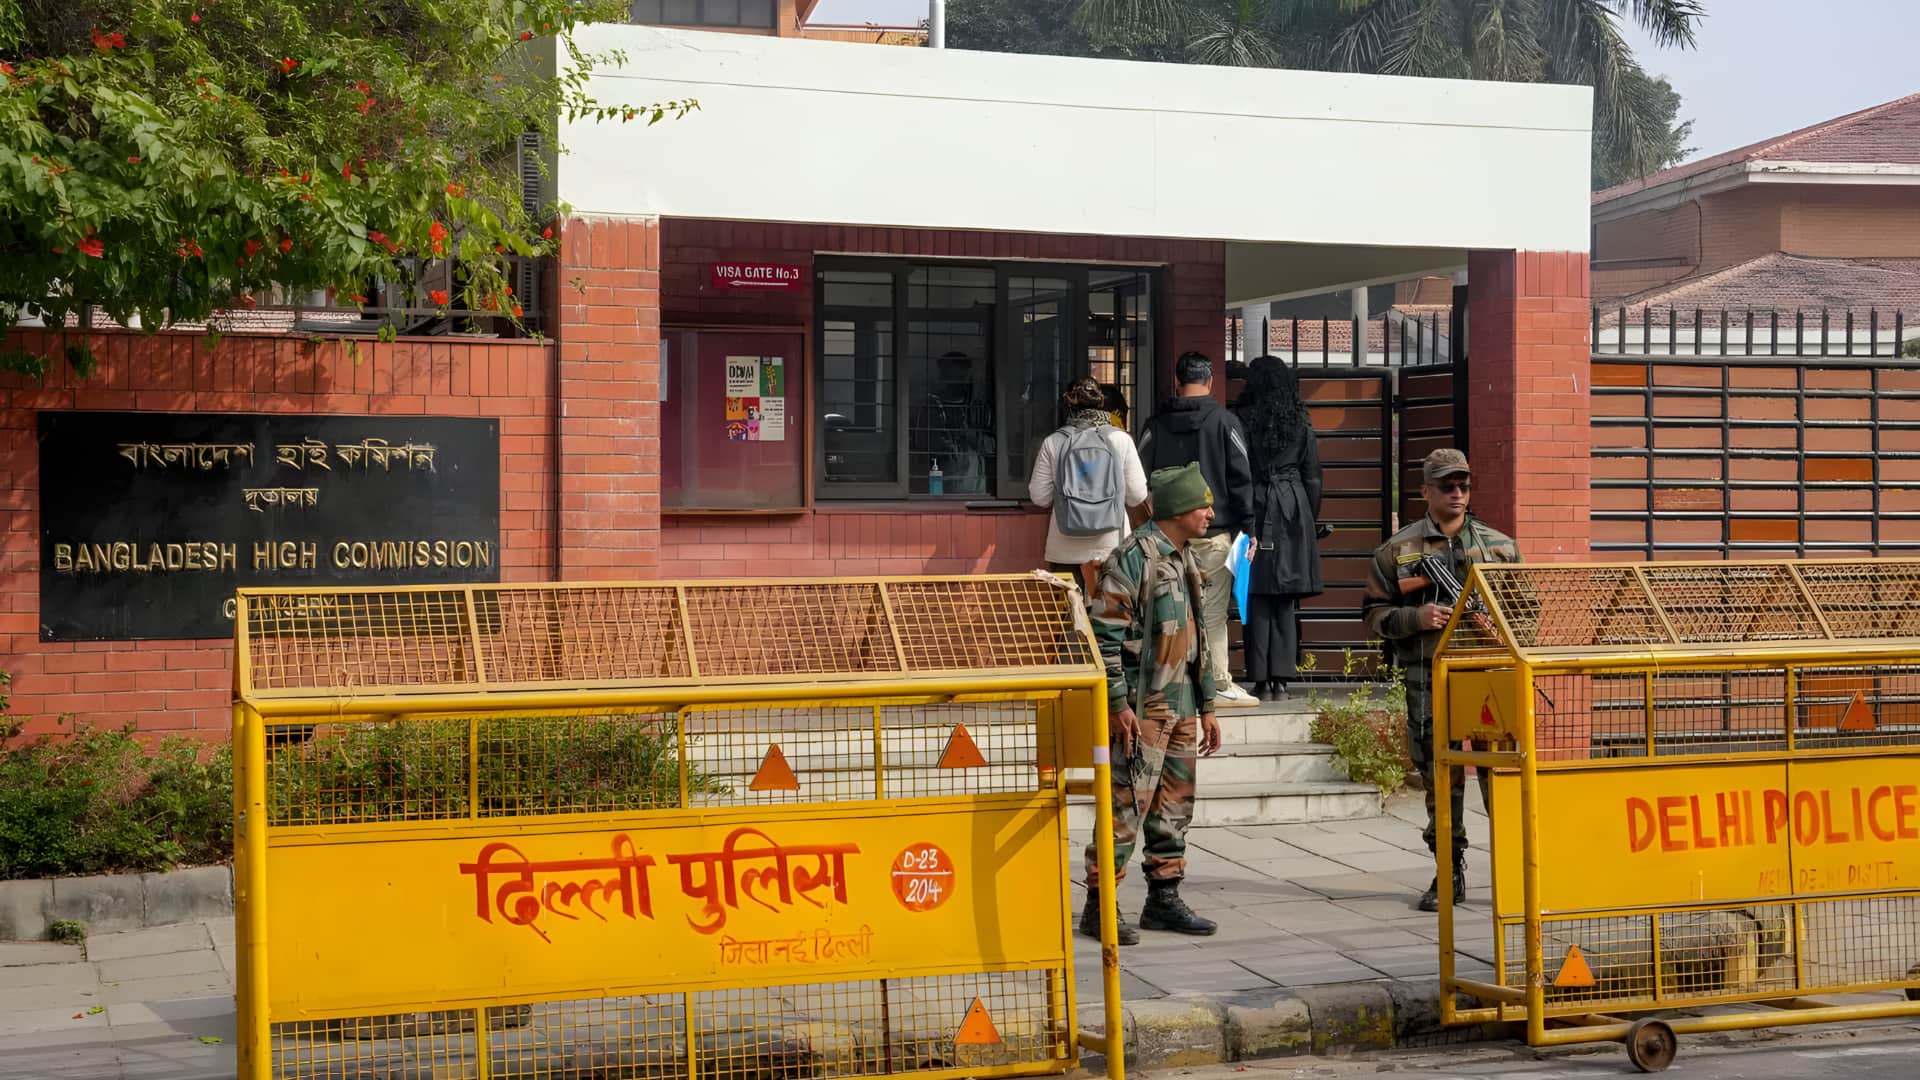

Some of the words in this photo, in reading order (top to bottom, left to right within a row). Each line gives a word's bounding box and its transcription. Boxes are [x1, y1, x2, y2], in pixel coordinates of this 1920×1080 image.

[716, 265, 742, 278] VISA
[744, 266, 773, 279] GATE
[775, 267, 799, 280] No.3
[117, 441, 256, 470] বাংলাদেশ
[275, 436, 332, 471] হাই
[335, 437, 437, 473] কমিশন
[54, 542, 238, 571] BANGLADESH
[252, 541, 318, 570] HIGH
[332, 540, 492, 569] COMMISSION
[1626, 790, 1755, 853] DELHI
[1763, 785, 1919, 847] POLICE
[903, 848, 938, 869] D-23
[459, 832, 657, 944] दिल्ली
[667, 827, 861, 935] पुलिस
[905, 878, 943, 904] 204
